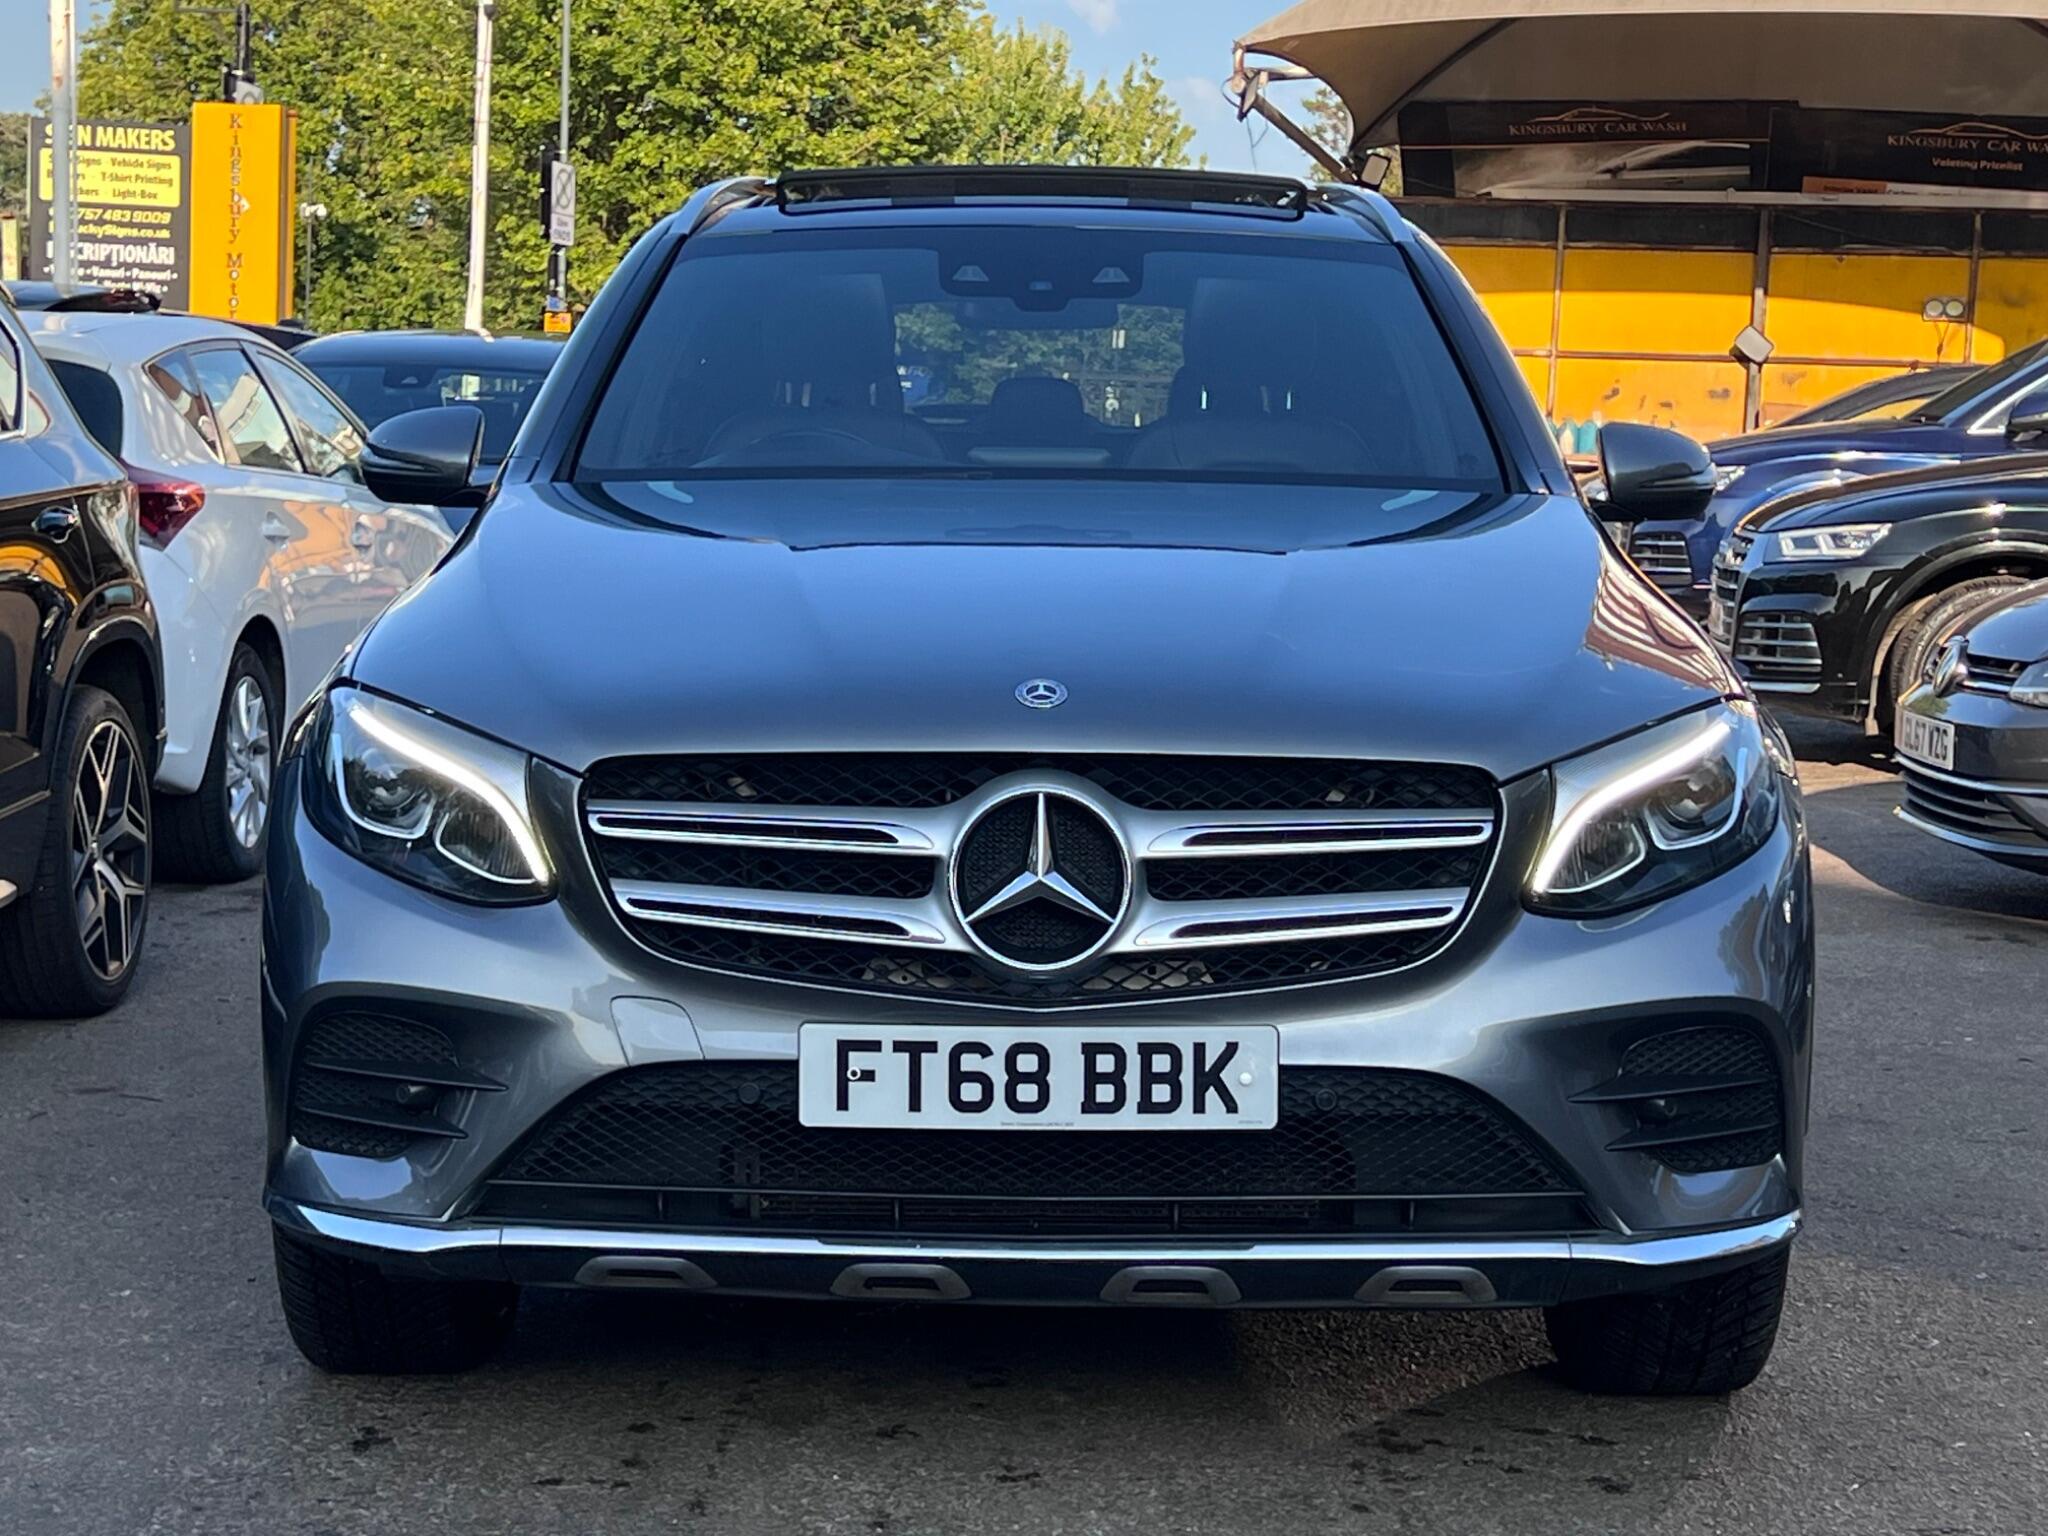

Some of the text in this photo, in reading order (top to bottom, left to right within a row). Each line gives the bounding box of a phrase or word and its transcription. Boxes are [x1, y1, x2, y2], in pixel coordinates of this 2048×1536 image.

[1508, 121, 1688, 136] KINGSBURY CAR WASH
[45, 123, 176, 151] SN MAKERS
[1887, 135, 1980, 149] KINGSBURY
[1987, 140, 2021, 151] CAR
[110, 158, 144, 169] Vehicle
[147, 159, 172, 171] Signs
[135, 174, 173, 187] Printing
[229, 113, 243, 244] Kingsbury
[102, 209, 132, 222] 483
[836, 1039, 1240, 1114] FT68 BBK
